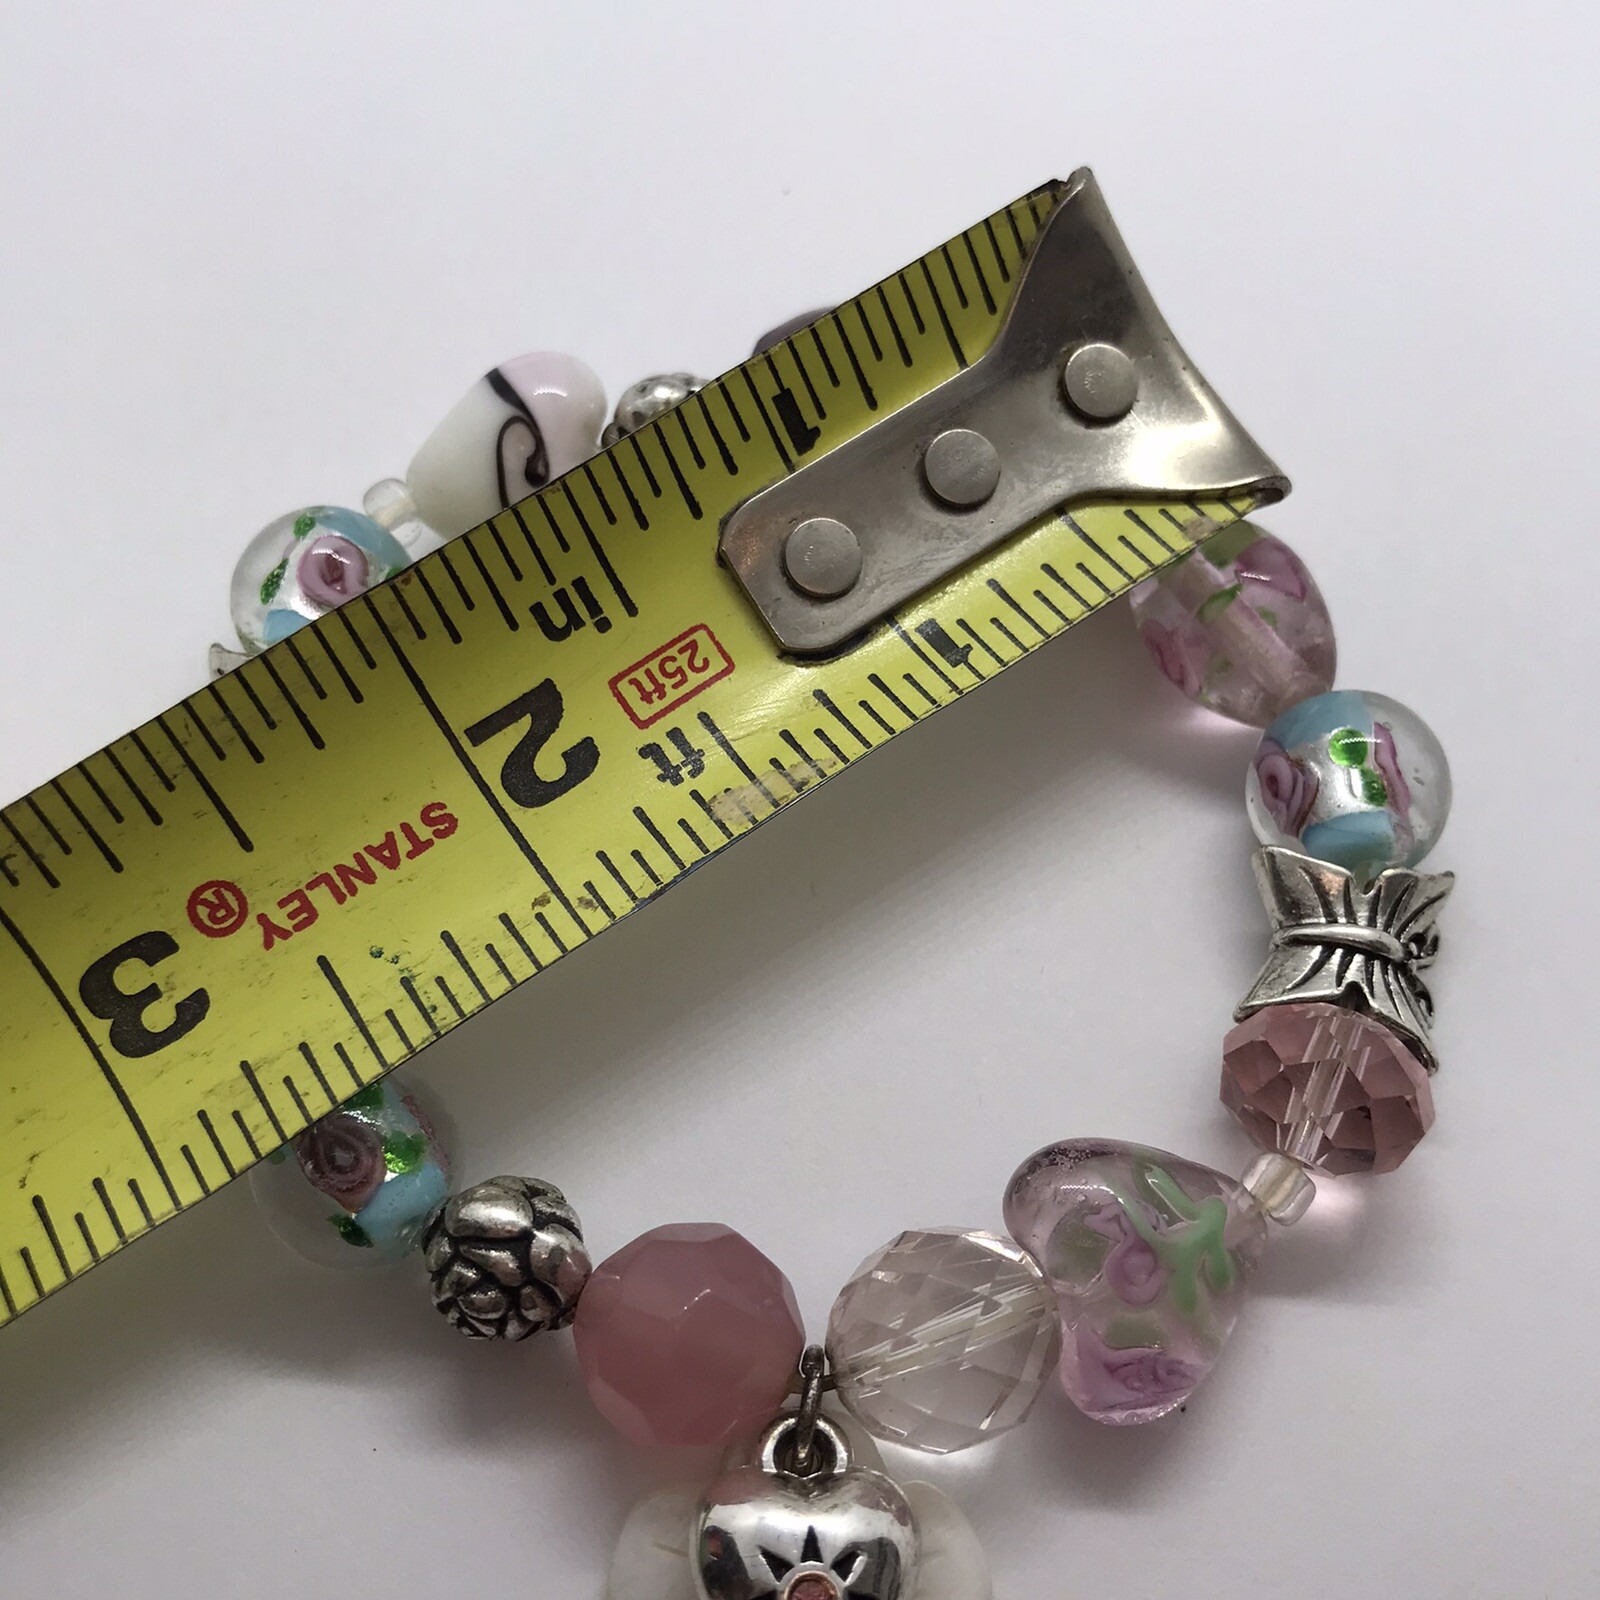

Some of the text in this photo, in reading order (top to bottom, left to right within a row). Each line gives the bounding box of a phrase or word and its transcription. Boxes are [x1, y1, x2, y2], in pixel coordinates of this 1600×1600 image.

[772, 388, 821, 456] 1
[529, 576, 613, 642] in
[629, 639, 710, 704] 25ft
[915, 618, 973, 669] 1
[464, 678, 600, 808] 2
[638, 727, 705, 786] ft
[256, 801, 459, 950] STANLEY
[79, 930, 210, 1058] 3
